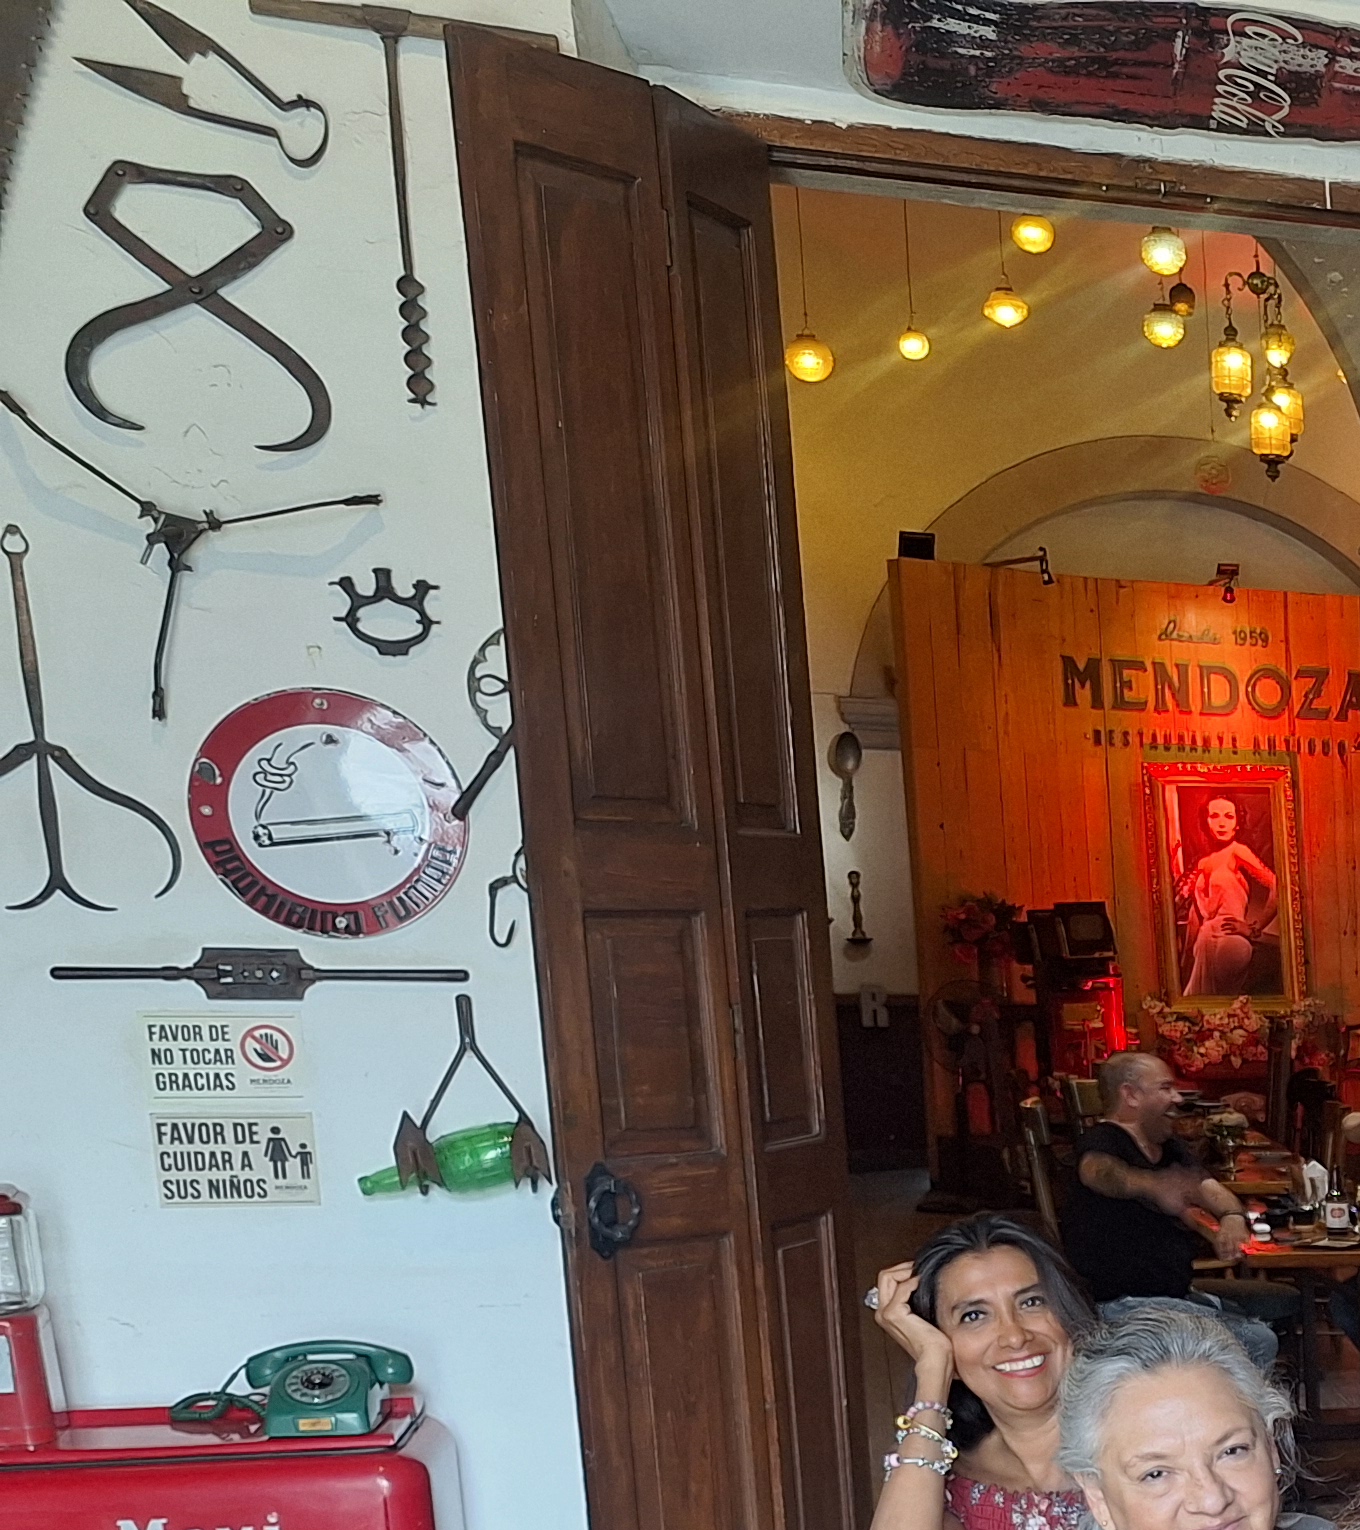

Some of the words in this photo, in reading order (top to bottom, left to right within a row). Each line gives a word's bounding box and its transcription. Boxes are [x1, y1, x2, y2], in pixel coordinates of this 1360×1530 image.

[1231, 626, 1270, 648] 1959
[203, 839, 365, 935] PROHIBIDO
[147, 1024, 204, 1042] FAVOR
[208, 1024, 231, 1042] DE
[151, 1048, 174, 1066] NO
[178, 1048, 236, 1066] TOCAR
[155, 1072, 236, 1092] GRACIAS
[155, 1122, 227, 1145] FAVOR
[232, 1122, 261, 1145] DE
[159, 1150, 235, 1172] CUIDAR
[240, 1150, 255, 1171] A
[162, 1178, 201, 1200] SUS
[207, 1174, 268, 1199] NIÑOS
